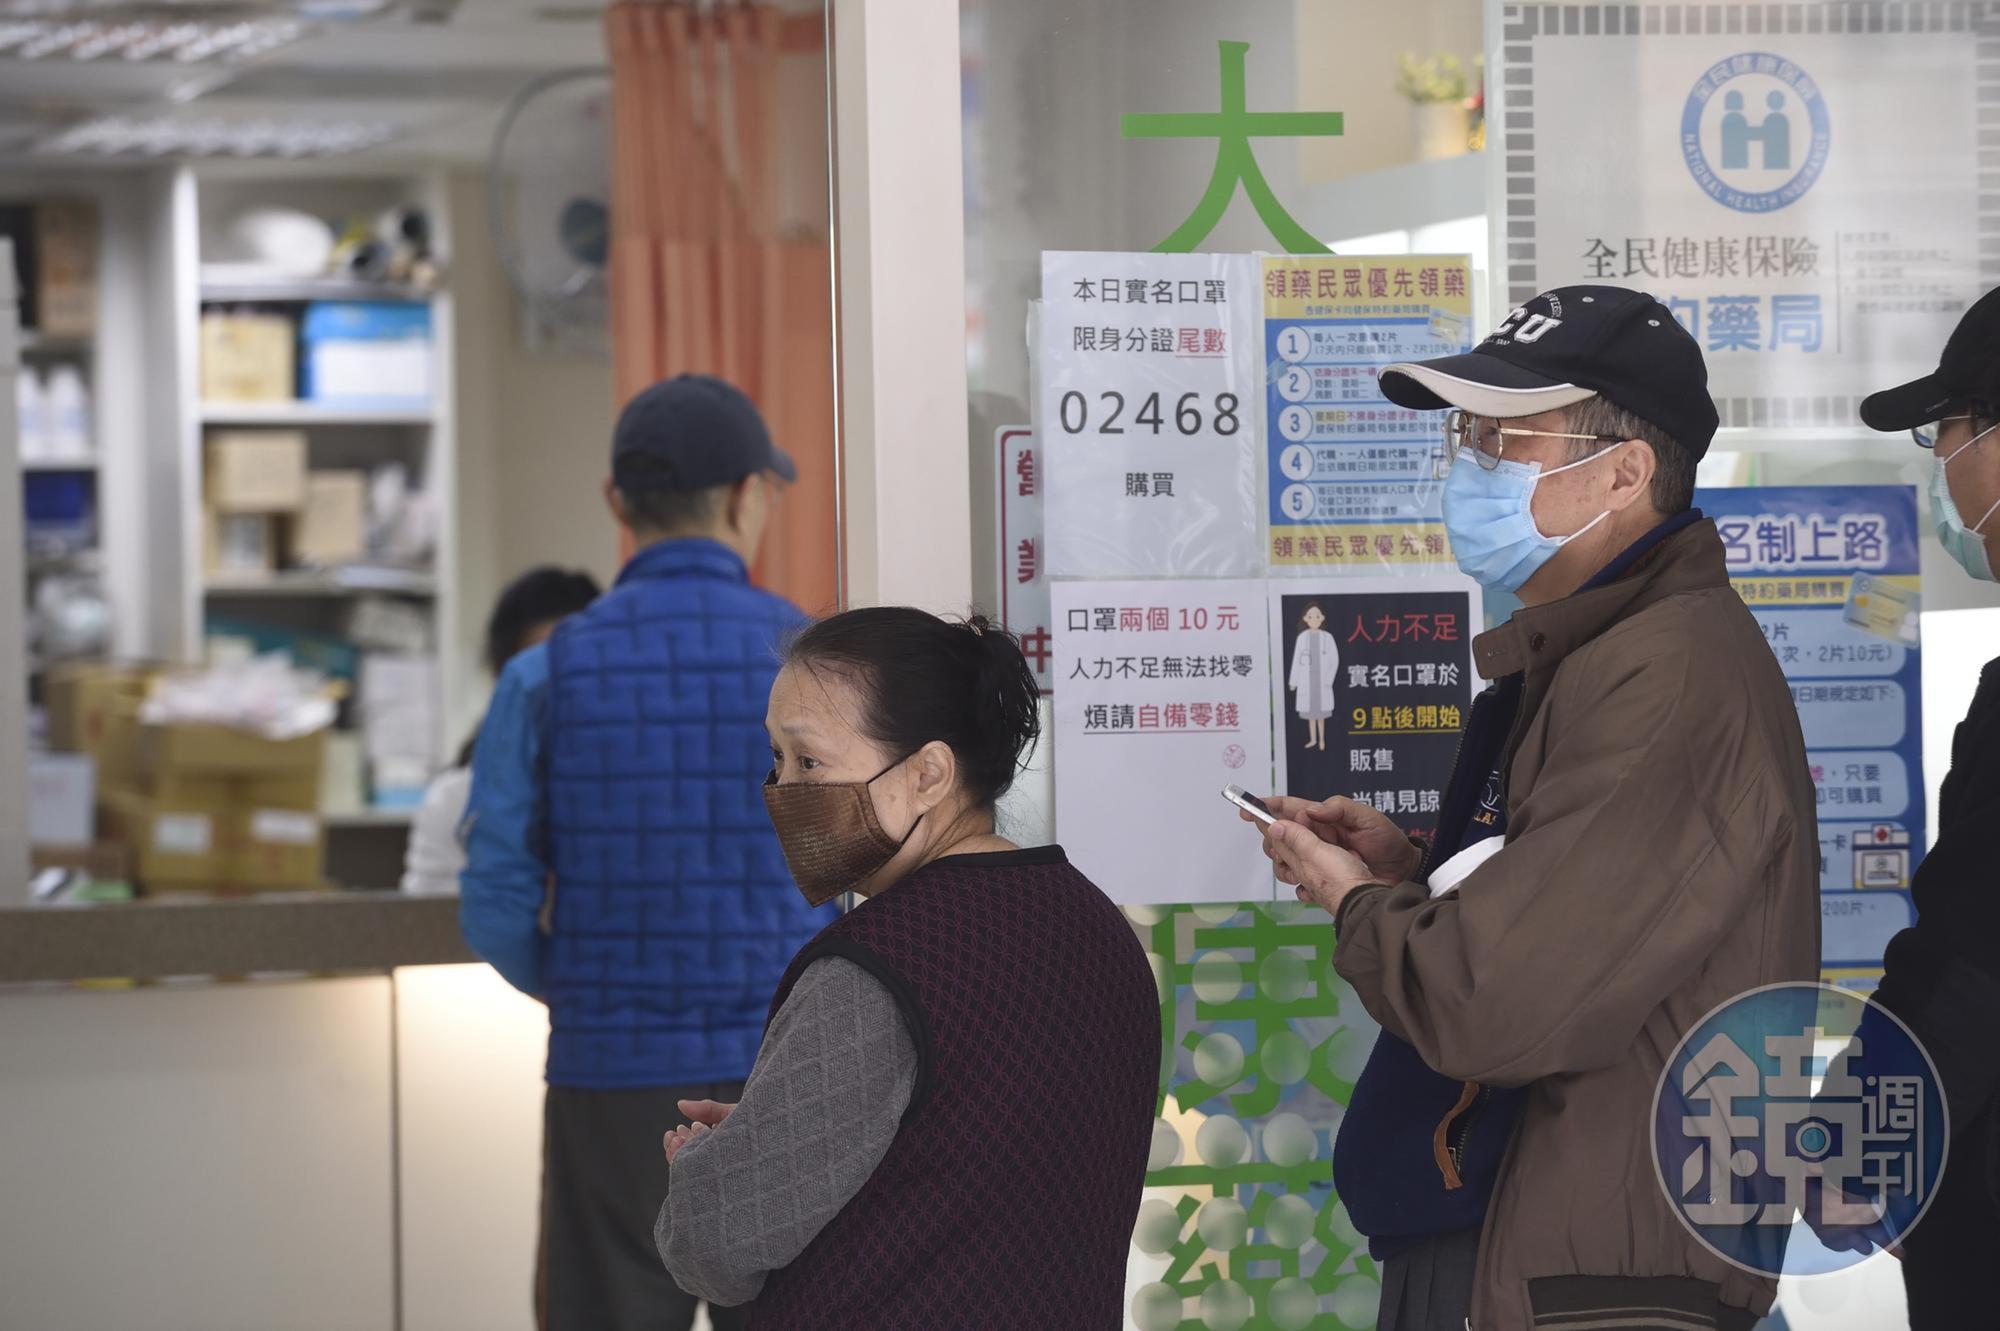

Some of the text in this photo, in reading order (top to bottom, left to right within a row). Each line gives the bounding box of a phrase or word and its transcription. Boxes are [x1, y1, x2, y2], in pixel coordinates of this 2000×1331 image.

[1120, 40, 1344, 255] 大
[1582, 236, 1820, 279] 全民健康保險
[1072, 277, 1228, 305] 本日實名口罩
[1266, 267, 1466, 300] 領藥民眾優先領藥
[1072, 326, 1228, 354] 限身分證尾數
[1287, 334, 1299, 354] 1
[1289, 373, 1299, 393] 2
[1289, 413, 1300, 433] 3
[1291, 452, 1303, 472] 4
[1125, 471, 1176, 498] 購買
[1292, 491, 1304, 512] 5
[1273, 534, 1456, 558] 領藥民眾優先領
[1067, 605, 1240, 634] 口罩兩個 10 元
[1347, 613, 1459, 644] 人力不足
[1069, 654, 1253, 681] 人力不足無法找零
[1347, 661, 1460, 689] 實名口罩於
[1083, 702, 1240, 731] 煩請自備零錢
[1349, 748, 1394, 773] 販售
